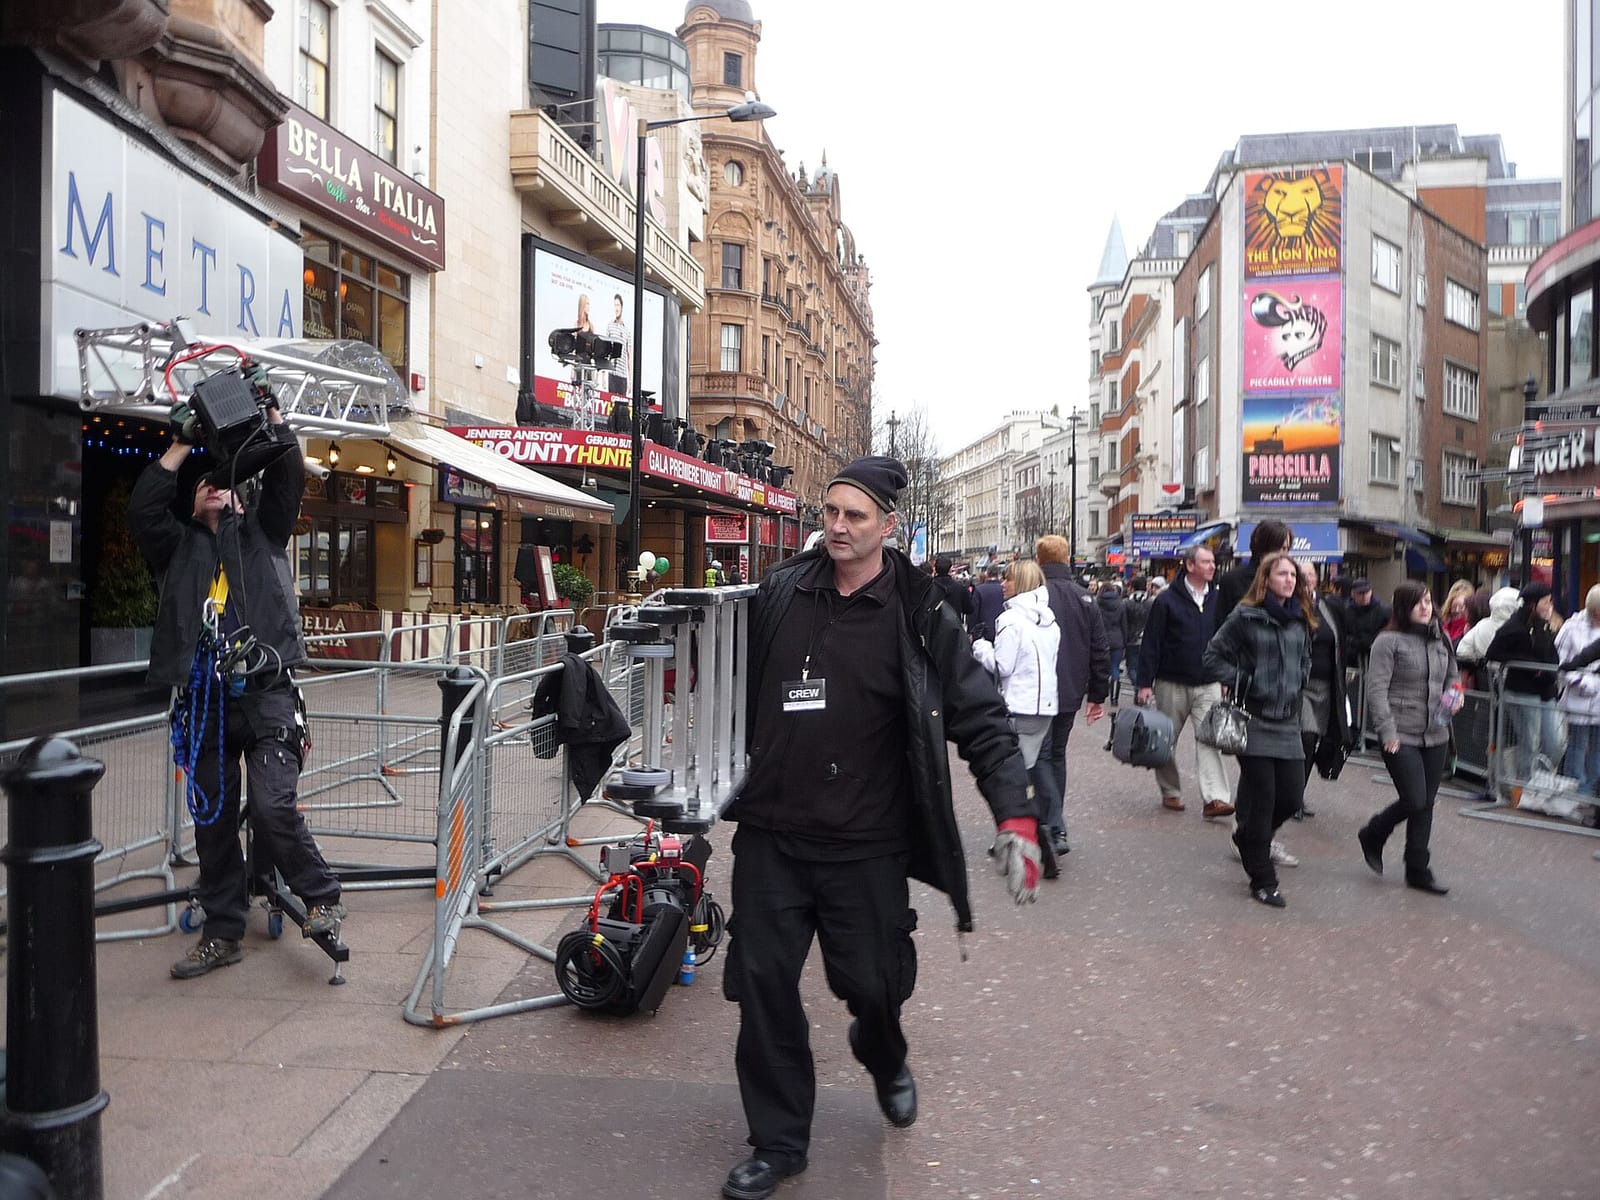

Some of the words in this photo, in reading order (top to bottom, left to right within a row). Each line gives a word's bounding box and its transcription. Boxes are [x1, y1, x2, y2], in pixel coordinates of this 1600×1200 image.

[288, 118, 363, 193] BELLA
[374, 171, 437, 235] ITALIA
[60, 170, 294, 338] METRA
[1247, 248, 1269, 264] THE
[1272, 245, 1302, 266] LION
[1305, 244, 1337, 262] KING
[1249, 376, 1296, 387] PICCADILLY
[1298, 375, 1333, 385] THEATRE
[465, 428, 512, 440] JENNIFER
[513, 431, 562, 442] ANISTON
[585, 434, 619, 446] GERARD
[619, 437, 632, 448] BUT
[576, 446, 632, 468] HUNTE
[1249, 453, 1331, 478] PRISCILLA
[648, 450, 670, 474] GALA
[670, 458, 700, 484] PREMIERE
[700, 467, 722, 491] TONIGHT
[1249, 475, 1274, 485] QUEEN
[1275, 475, 1285, 484] OF
[1287, 475, 1300, 483] THE
[1302, 474, 1331, 483] DESERT
[1260, 492, 1287, 501] PALACE
[1288, 491, 1320, 501] THEATRE
[788, 688, 820, 699] CREW
